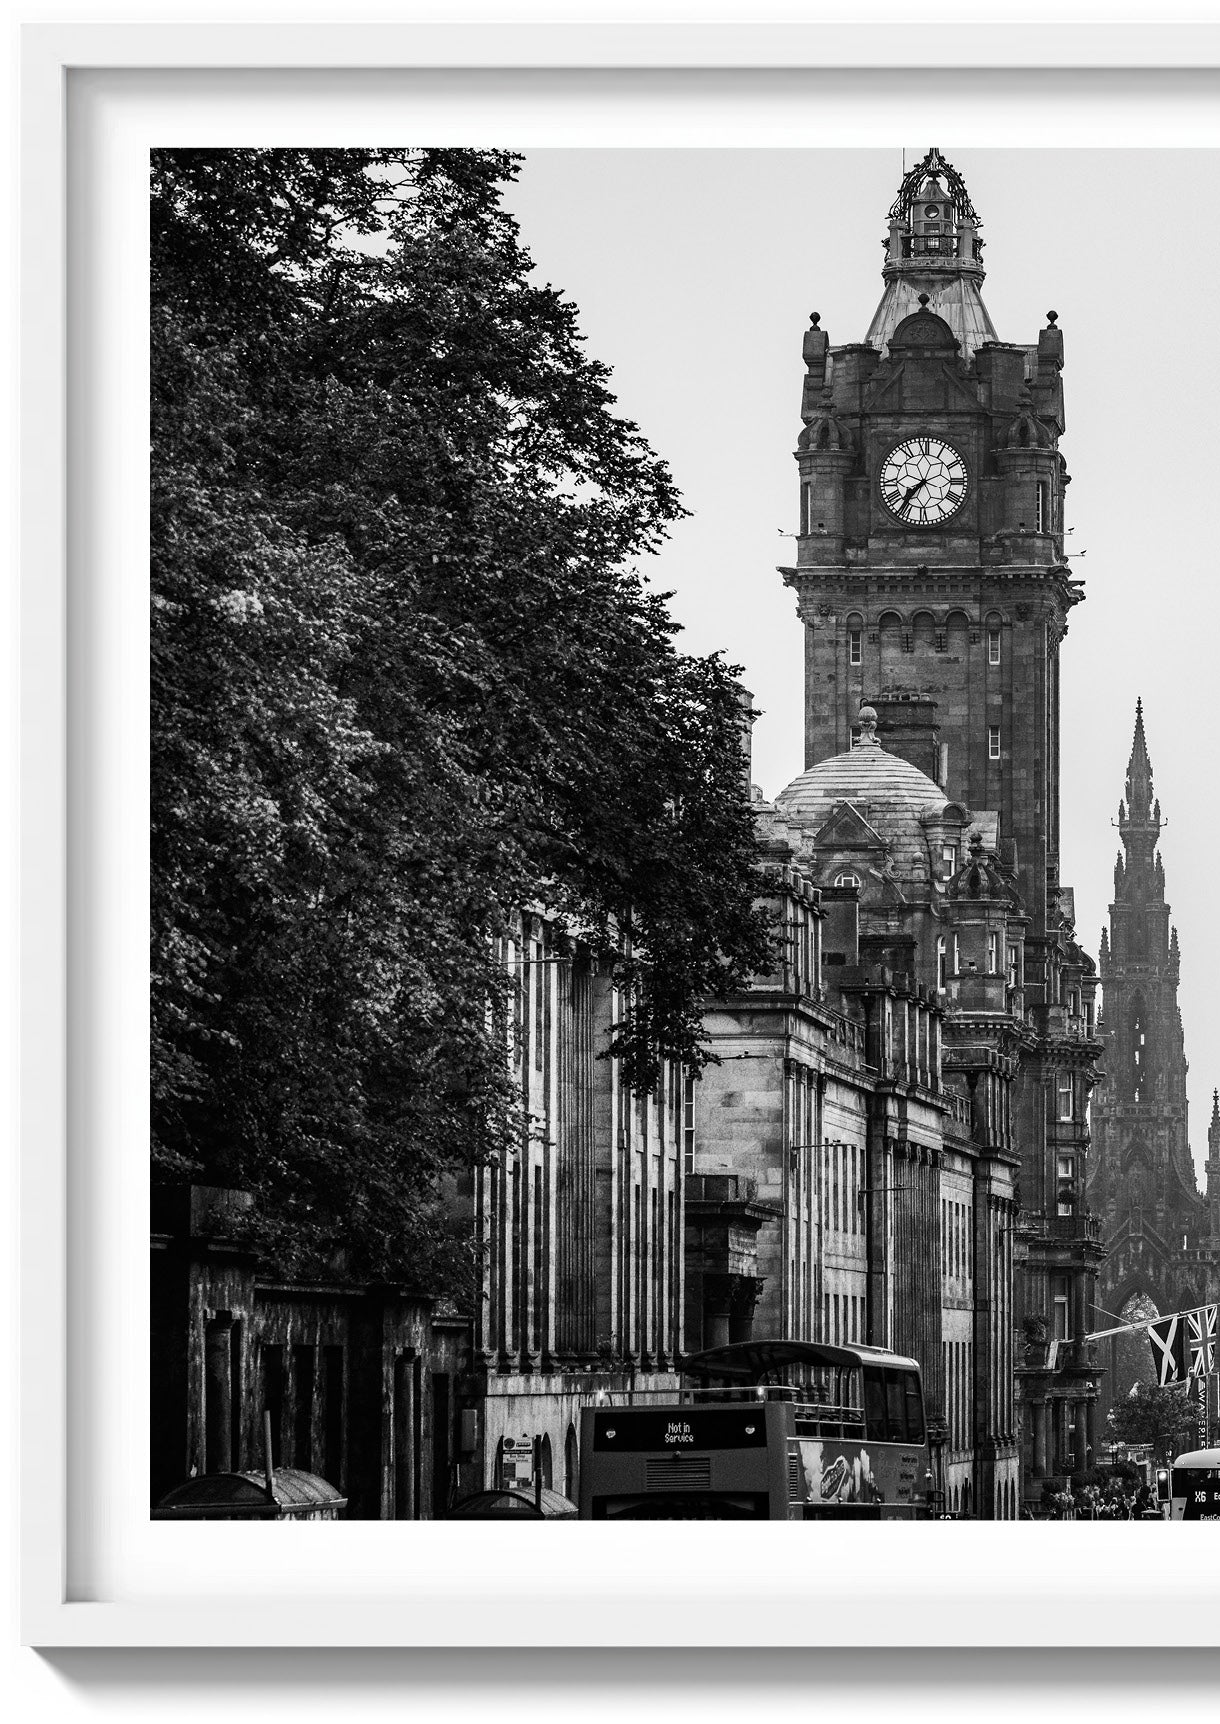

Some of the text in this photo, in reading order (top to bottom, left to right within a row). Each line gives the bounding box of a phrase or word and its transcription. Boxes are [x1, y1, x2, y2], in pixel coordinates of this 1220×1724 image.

[668, 1422, 690, 1433] Not in
[664, 1433, 694, 1443] Service
[1194, 1491, 1206, 1503] X6
